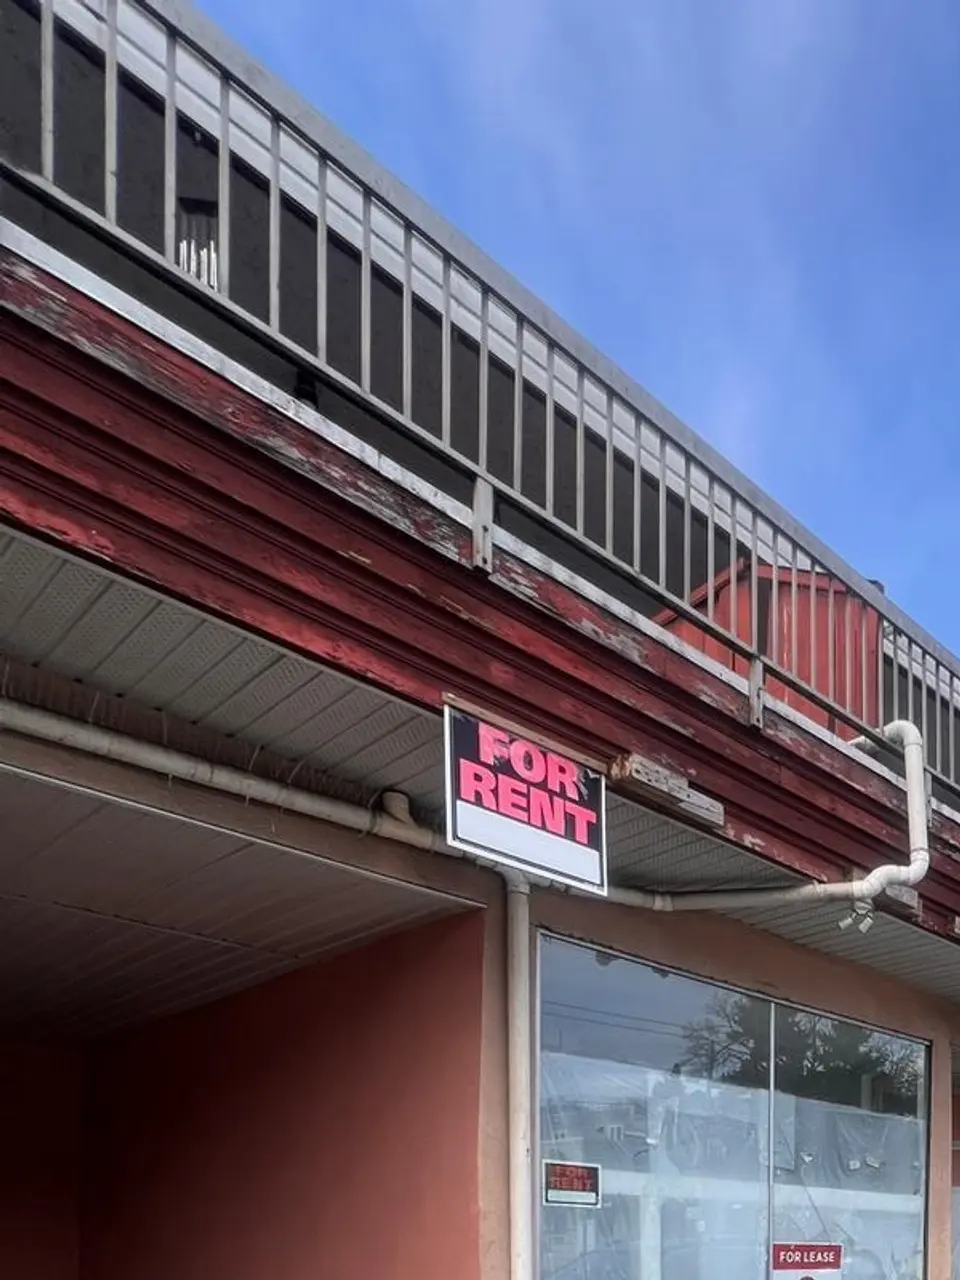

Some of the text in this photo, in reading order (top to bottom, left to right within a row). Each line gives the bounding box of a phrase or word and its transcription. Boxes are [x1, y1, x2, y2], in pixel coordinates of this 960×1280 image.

[478, 721, 581, 801] FOR
[459, 758, 597, 845] RENT
[549, 1176, 594, 1191] RENT
[779, 1251, 835, 1263] FOR LEASE
